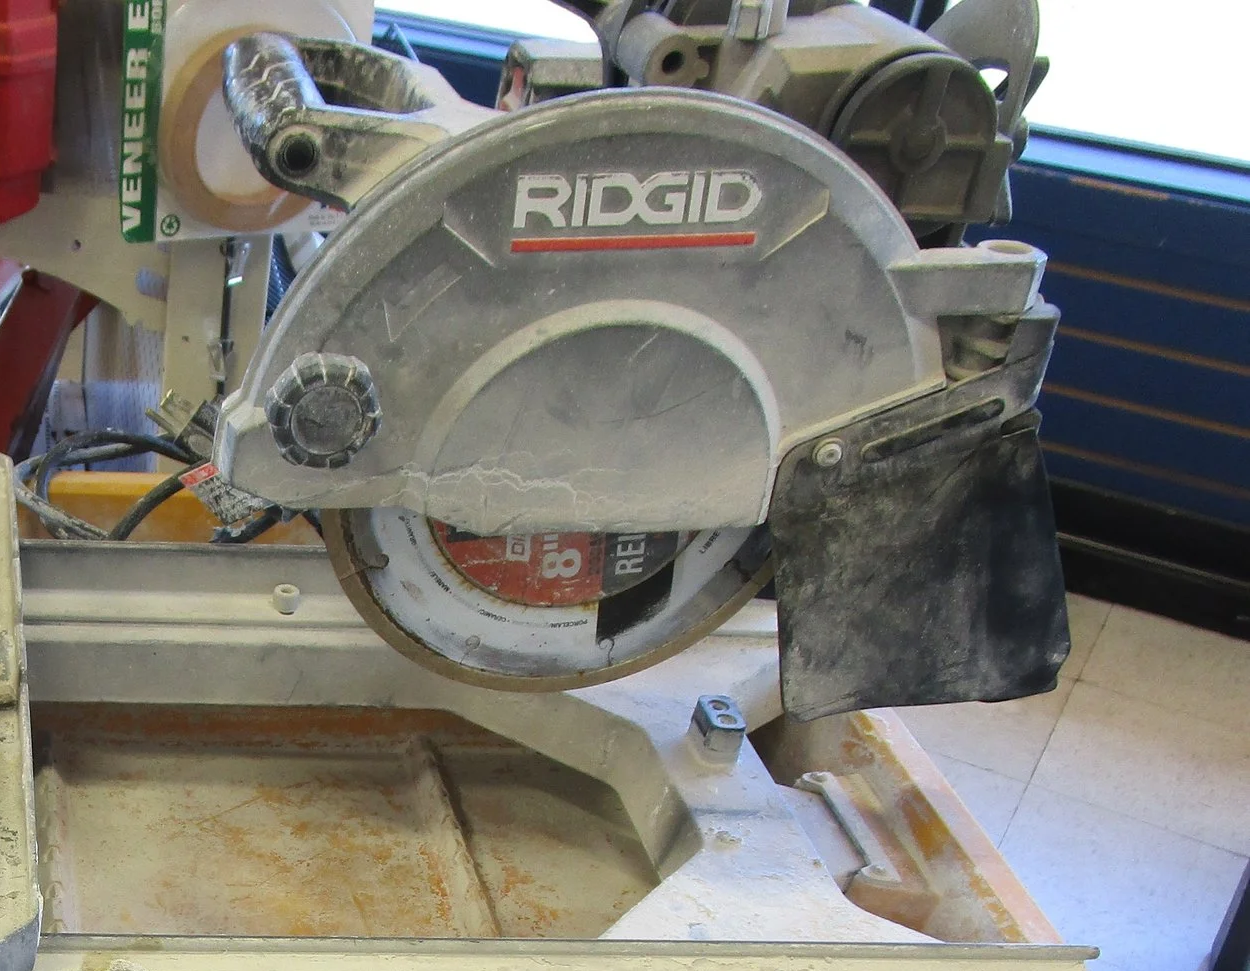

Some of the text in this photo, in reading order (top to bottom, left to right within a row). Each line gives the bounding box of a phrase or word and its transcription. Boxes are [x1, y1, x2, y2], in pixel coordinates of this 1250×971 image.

[121, 47, 150, 233] VENEER
[513, 168, 763, 229] RIDGID
[699, 529, 721, 554] LIBRE
